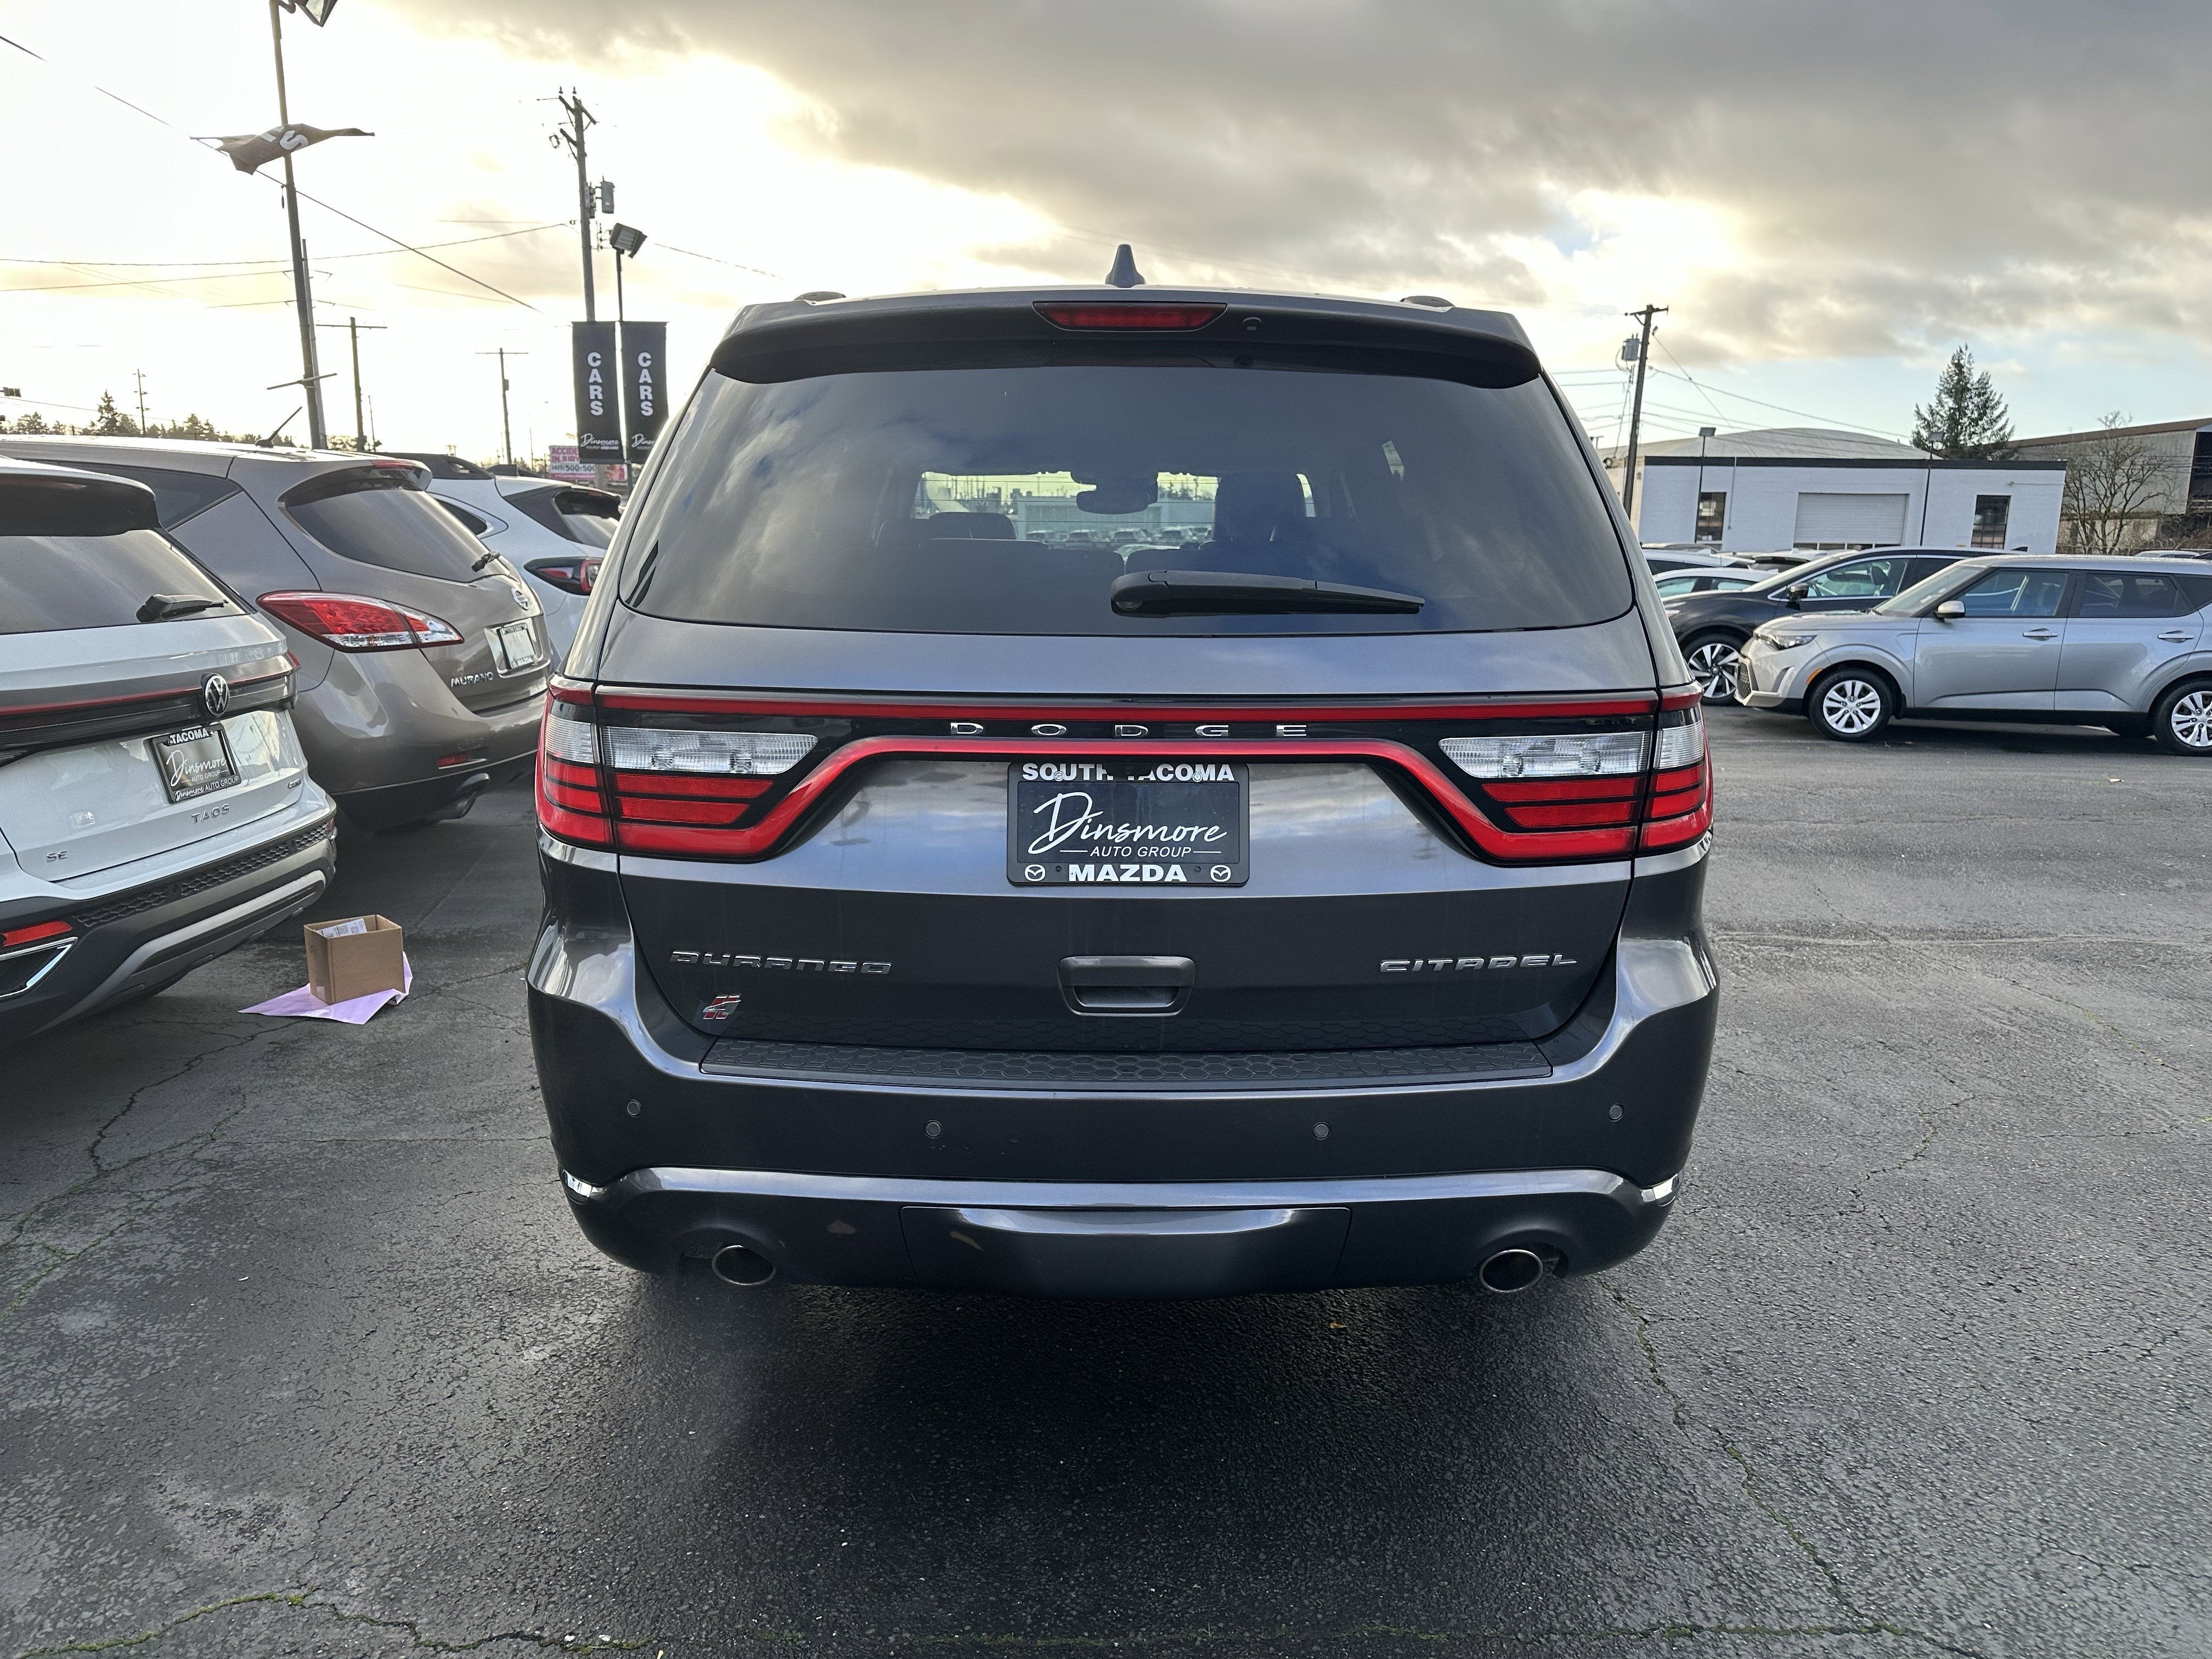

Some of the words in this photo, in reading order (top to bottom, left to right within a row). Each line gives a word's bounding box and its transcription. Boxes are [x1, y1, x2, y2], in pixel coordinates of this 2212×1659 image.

[587, 352, 603, 416] CARS
[637, 352, 653, 416] CARS
[451, 672, 494, 687] MURANO
[170, 728, 209, 744] TACOMA
[950, 722, 1307, 737] DODGE
[166, 750, 227, 787] Dinsmore
[205, 770, 221, 779] GROUP
[1121, 763, 1234, 781] ACOMA
[175, 788, 204, 802] Dinsmore
[205, 782, 219, 791] AUTO
[220, 776, 239, 787] GROUP
[191, 803, 230, 823] TAOS
[1028, 791, 1228, 855] Dinsmore
[46, 850, 68, 862] SE
[1090, 847, 1132, 857] AUTO
[1137, 846, 1192, 857] GROUP
[1069, 864, 1188, 882] MAZDA
[670, 950, 892, 974] DURANGO
[1380, 953, 1577, 972] CITADEL
